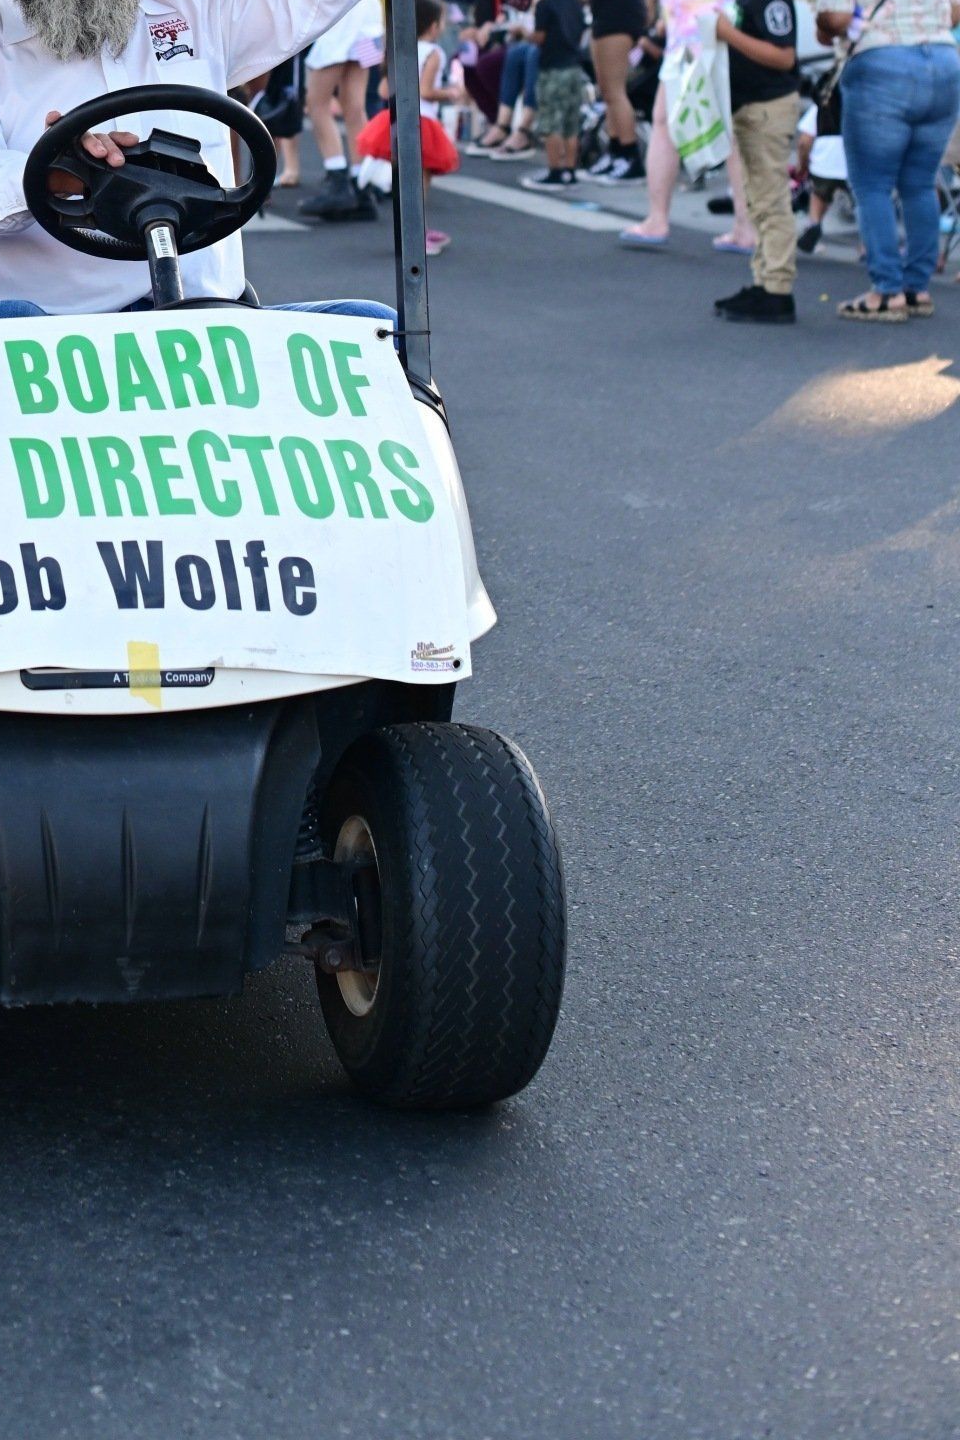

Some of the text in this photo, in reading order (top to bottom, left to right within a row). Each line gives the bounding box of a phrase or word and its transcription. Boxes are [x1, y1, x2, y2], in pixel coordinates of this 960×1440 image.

[4, 325, 370, 417] BOARD OF
[9, 430, 435, 523] DIRECTORS
[96, 539, 317, 616] Wolfe
[113, 672, 121, 683] A
[165, 672, 213, 684] Company
